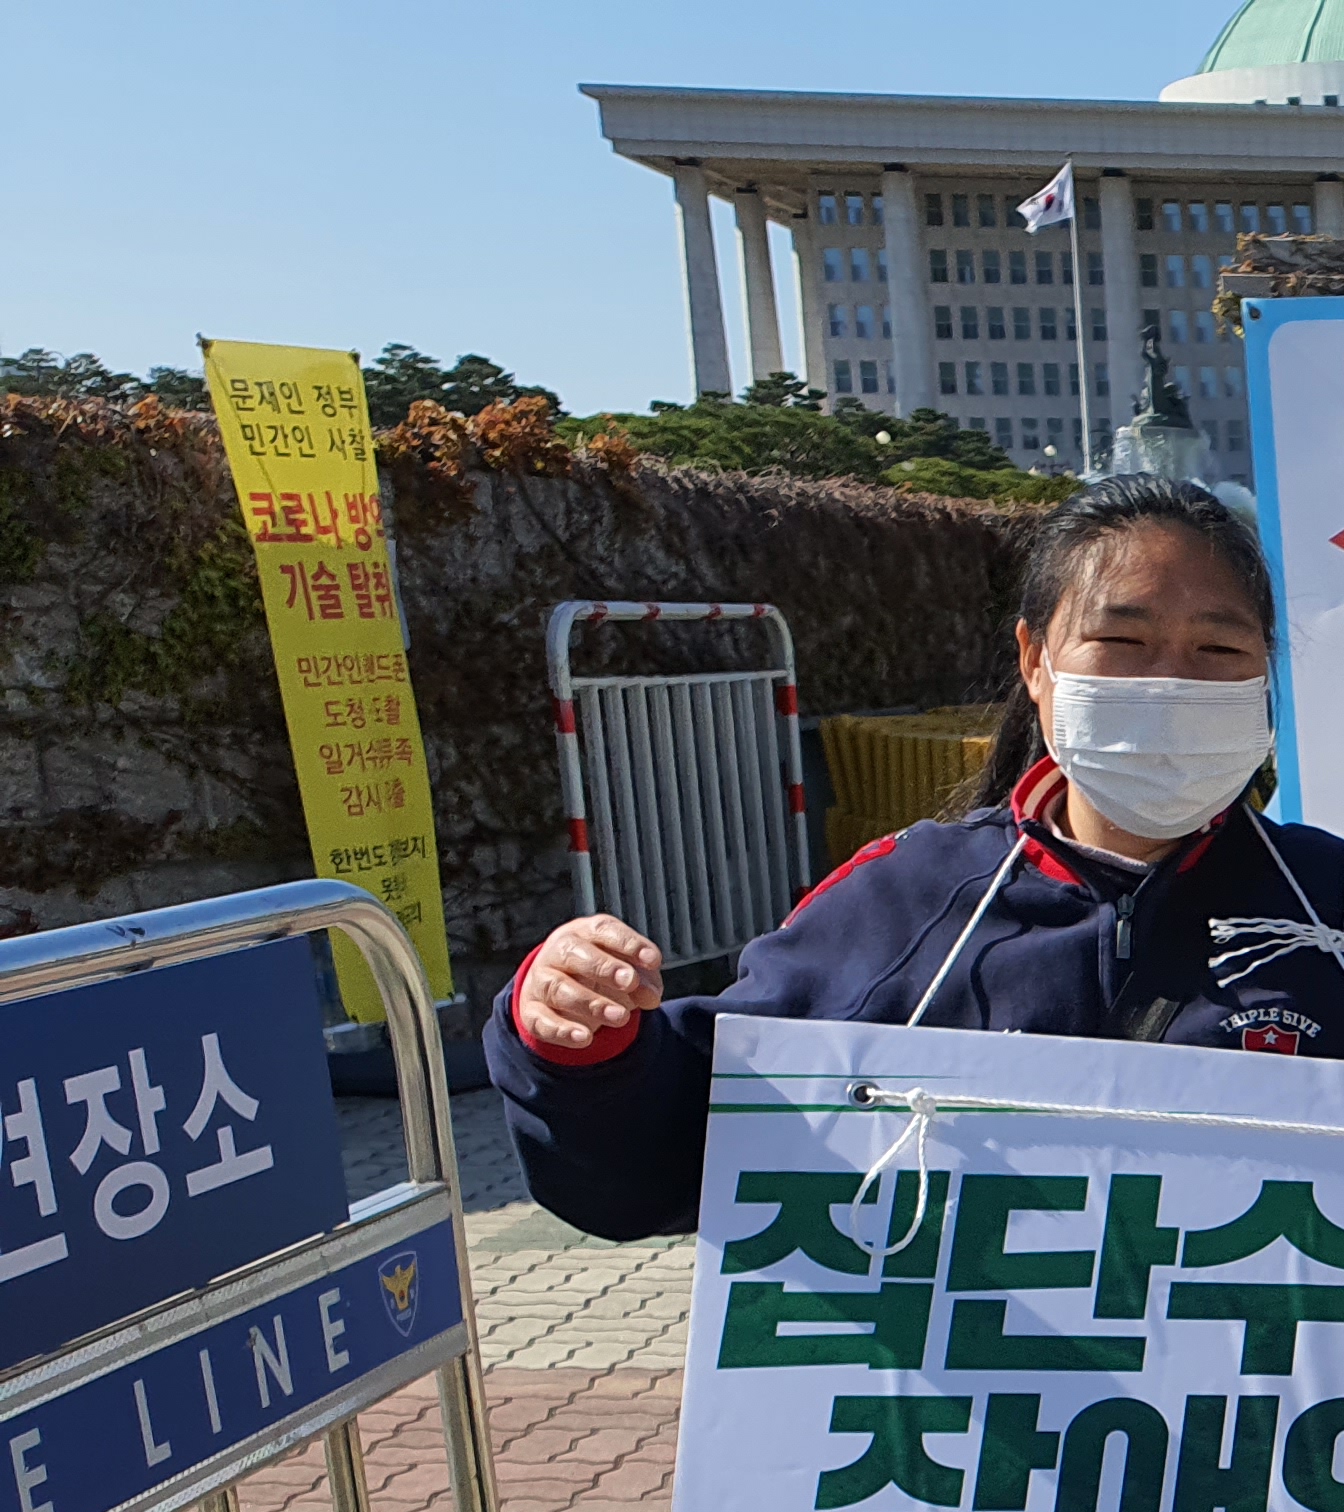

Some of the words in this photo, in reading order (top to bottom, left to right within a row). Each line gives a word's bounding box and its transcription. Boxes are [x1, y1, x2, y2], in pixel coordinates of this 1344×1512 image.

[230, 378, 305, 415] 문재인
[312, 384, 358, 418] 정부
[241, 423, 316, 458] 민간인
[328, 427, 367, 462] 사찰
[249, 490, 343, 549] 코로나
[279, 561, 344, 621] 기술
[1219, 1007, 1280, 1033] TRIPLE
[134, 1287, 349, 1468] LINE
